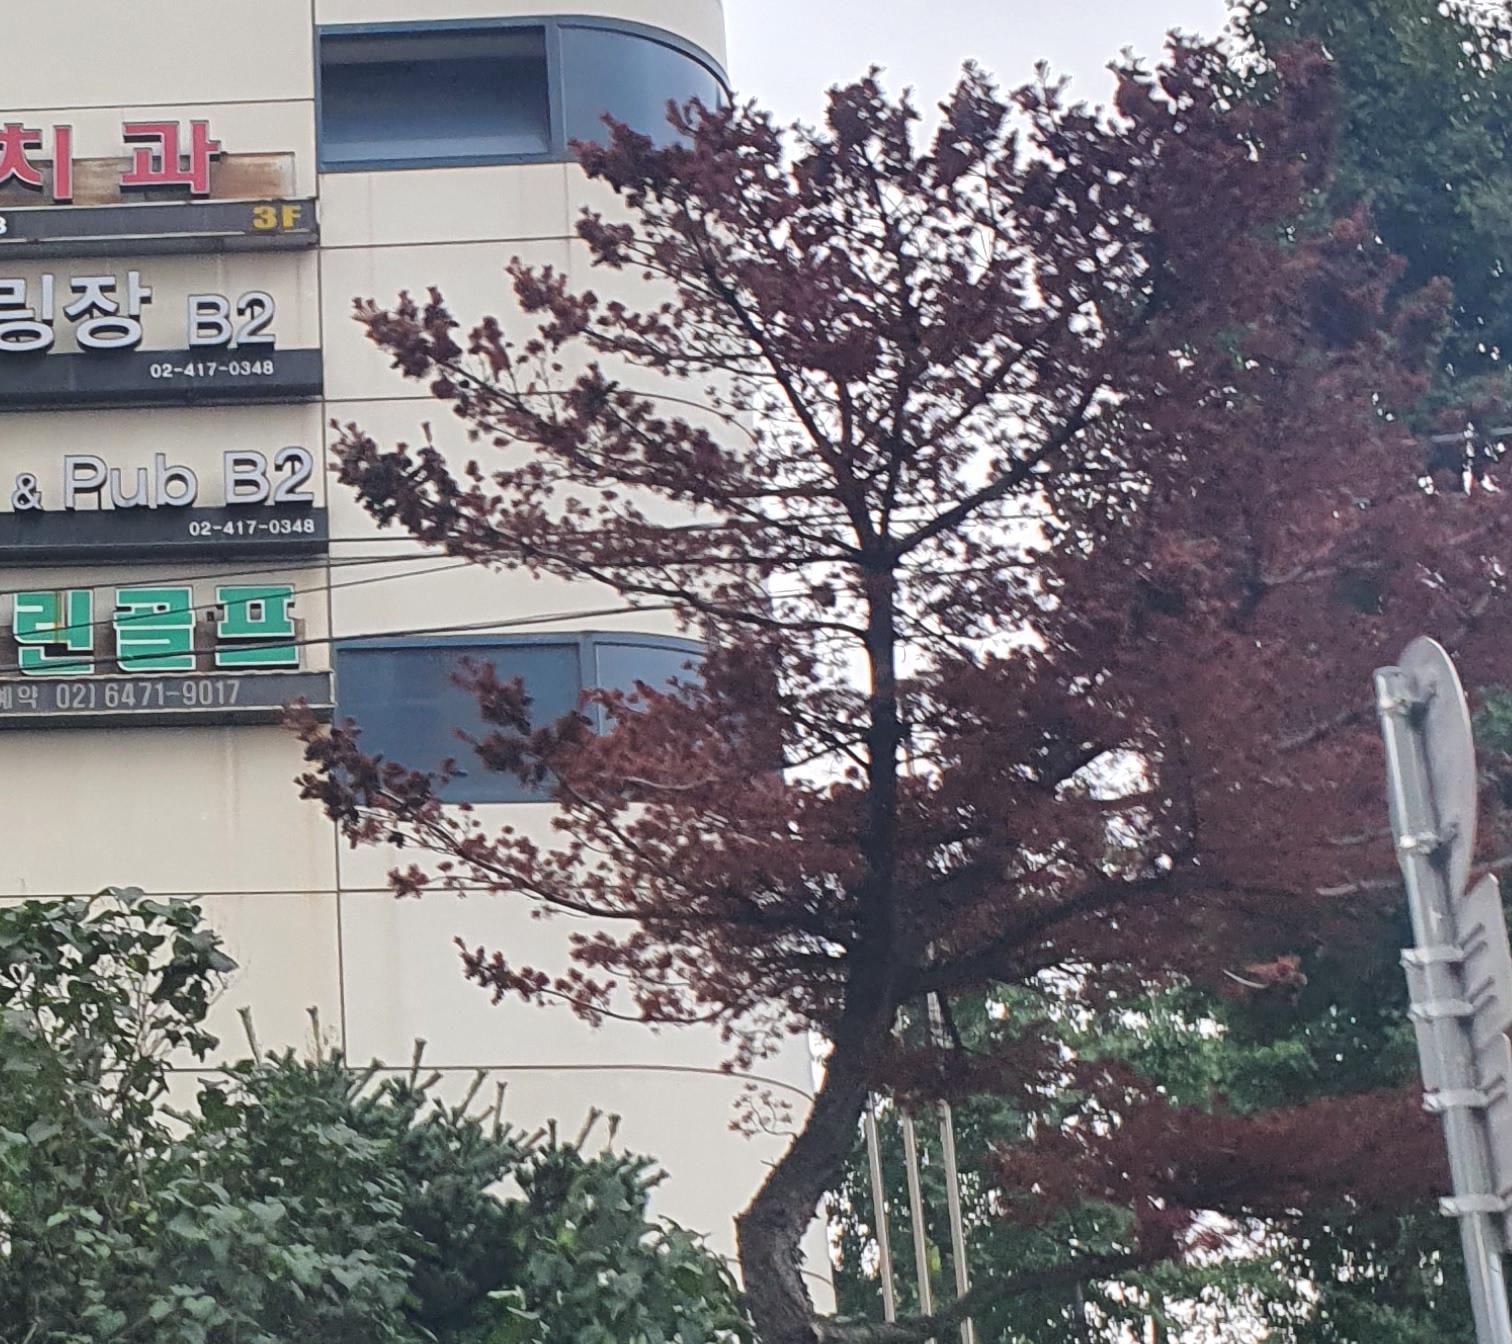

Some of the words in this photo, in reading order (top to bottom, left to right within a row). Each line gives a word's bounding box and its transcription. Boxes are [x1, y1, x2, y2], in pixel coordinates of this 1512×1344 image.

[252, 204, 304, 231] 3F
[186, 291, 276, 349] B2
[149, 358, 275, 380] 02-417-0348
[11, 474, 43, 510] &
[63, 453, 198, 511] Pub
[222, 446, 315, 506] B2
[188, 517, 315, 536] 02-417-0348
